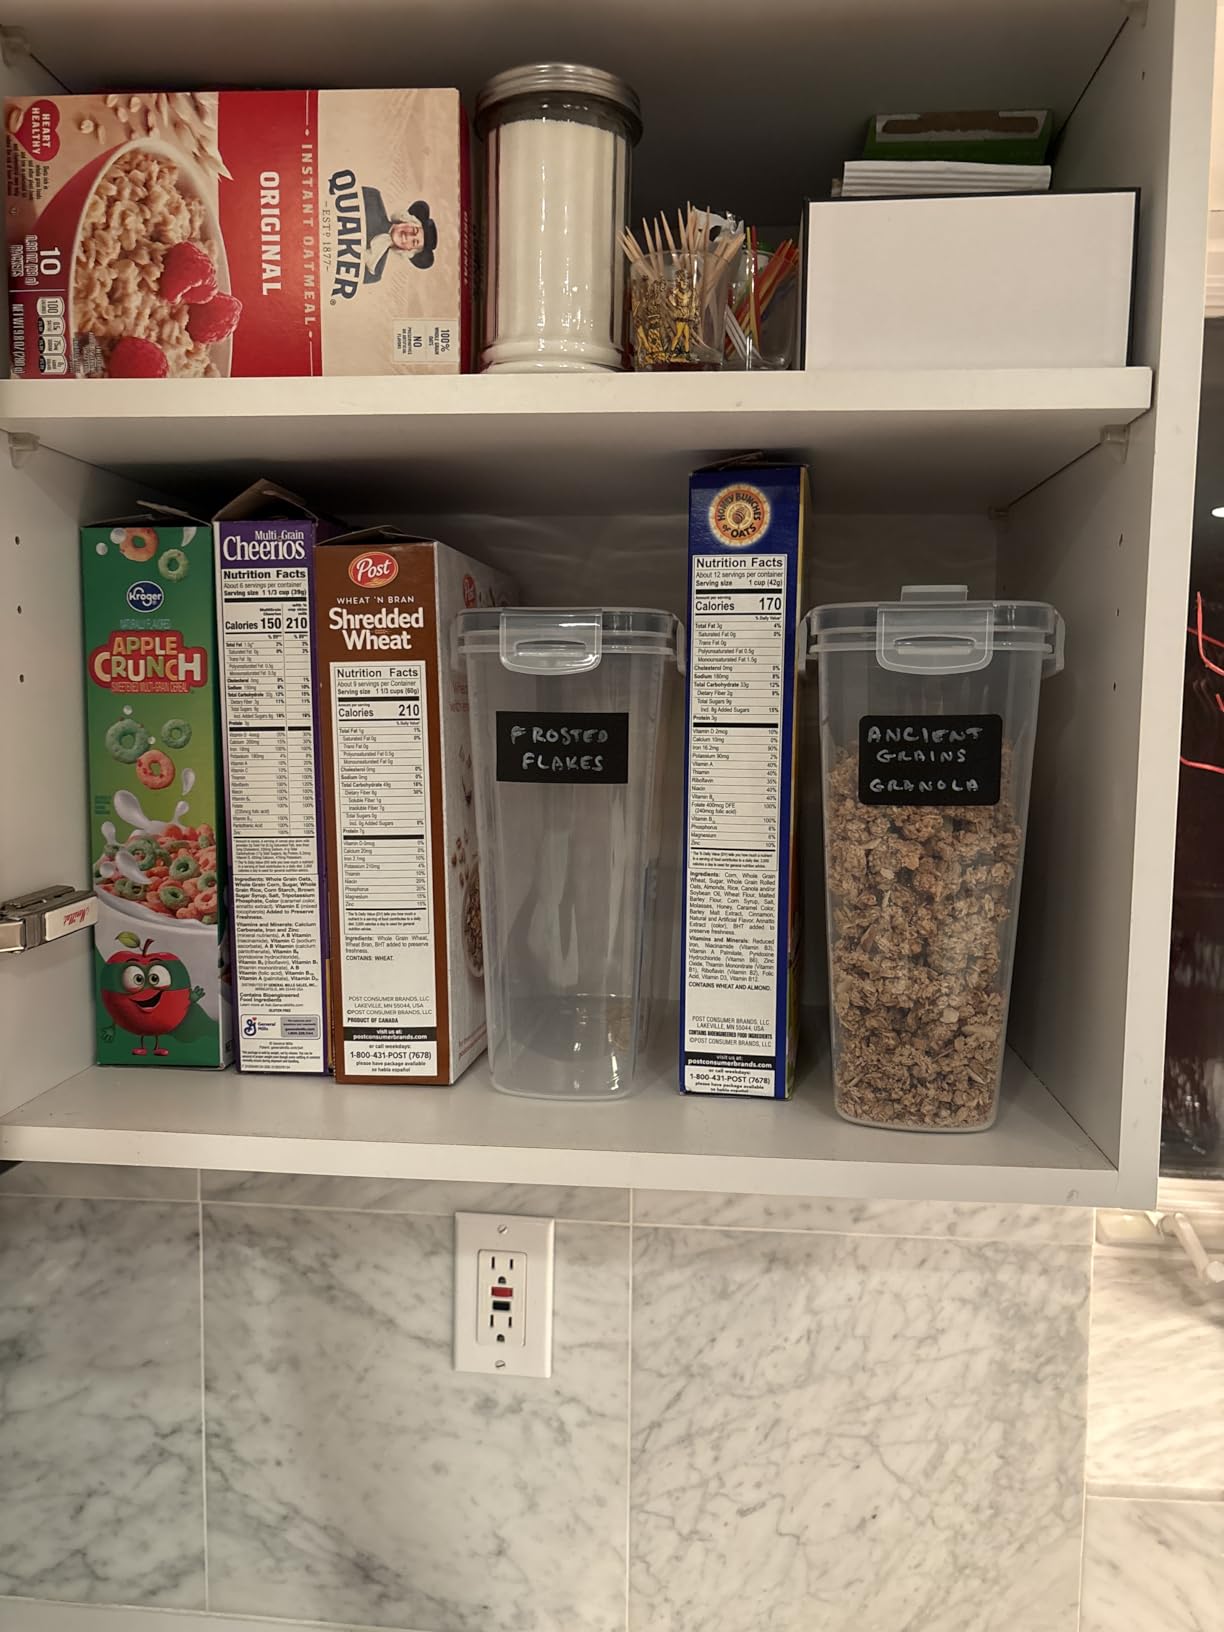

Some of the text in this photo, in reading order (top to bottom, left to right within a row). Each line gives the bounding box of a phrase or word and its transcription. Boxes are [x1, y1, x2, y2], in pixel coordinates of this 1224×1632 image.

[32, 107, 40, 155] HEALTHY
[42, 113, 51, 148] HEART
[260, 171, 281, 295] ORIGINAL
[302, 144, 316, 325] INSTANT OATMEAL
[328, 169, 362, 299] QUAKER
[40, 247, 60, 275] 10
[413, 336, 422, 348] NO
[440, 329, 450, 352] 100%
[718, 492, 761, 520] HONEY BUNCHES
[255, 530, 304, 540] Multi Grain
[730, 523, 756, 538] OATS
[223, 536, 305, 560] Cheerios
[357, 558, 392, 582] Post
[696, 558, 783, 568] Nutrition Facts
[224, 570, 306, 579] Nutrition Facts
[129, 587, 162, 606] Kroger
[696, 598, 781, 611] Calories 170
[225, 618, 307, 630] Calories 150 210
[329, 607, 424, 629] Shredded
[113, 637, 178, 655] APPLE
[342, 629, 412, 650] Wheat
[94, 652, 201, 682] CRUNCH
[337, 668, 418, 678] Nutrition Facts
[339, 709, 374, 717] Calories
[399, 704, 419, 716] 210
[510, 725, 609, 744] FROSTED
[867, 727, 983, 743] ANCIENT
[522, 752, 604, 772] FLAKES
[877, 749, 966, 762] GRAINS
[870, 779, 979, 792] GRANOLA
[688, 1059, 772, 1068] postconsumerbrands.com
[690, 1074, 746, 1082] 1-800-431-POST
